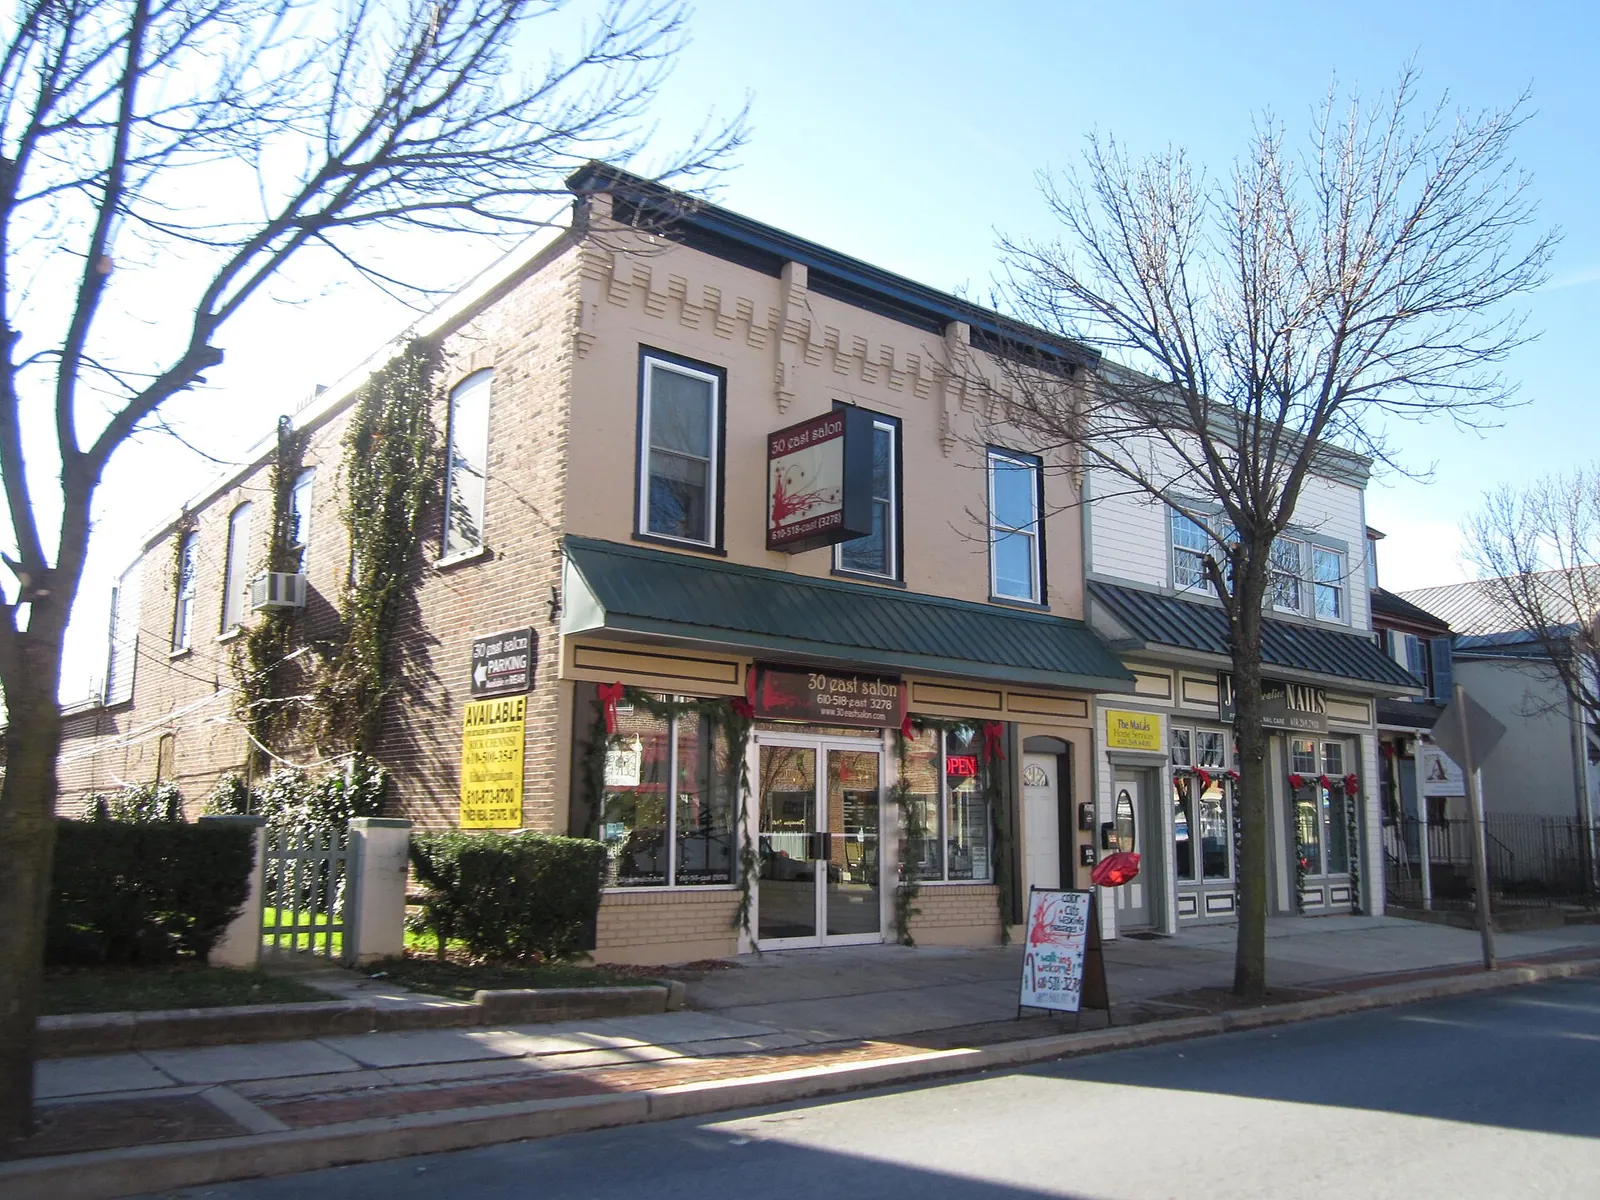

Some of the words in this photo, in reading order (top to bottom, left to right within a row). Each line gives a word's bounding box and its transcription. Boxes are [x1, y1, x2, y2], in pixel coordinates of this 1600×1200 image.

[772, 438, 786, 455] 30
[787, 429, 809, 450] east
[812, 421, 842, 441] salon
[473, 642, 486, 659] 30
[503, 635, 528, 652] salon
[487, 655, 527, 675] PARKING
[808, 673, 826, 690] 30
[829, 676, 858, 694] east
[861, 678, 897, 698] salon
[870, 698, 892, 710] 3278
[1286, 683, 1327, 716] NAILS
[465, 699, 523, 728] AVAILABLE
[1117, 718, 1129, 729] The
[1273, 717, 1285, 725] CARE
